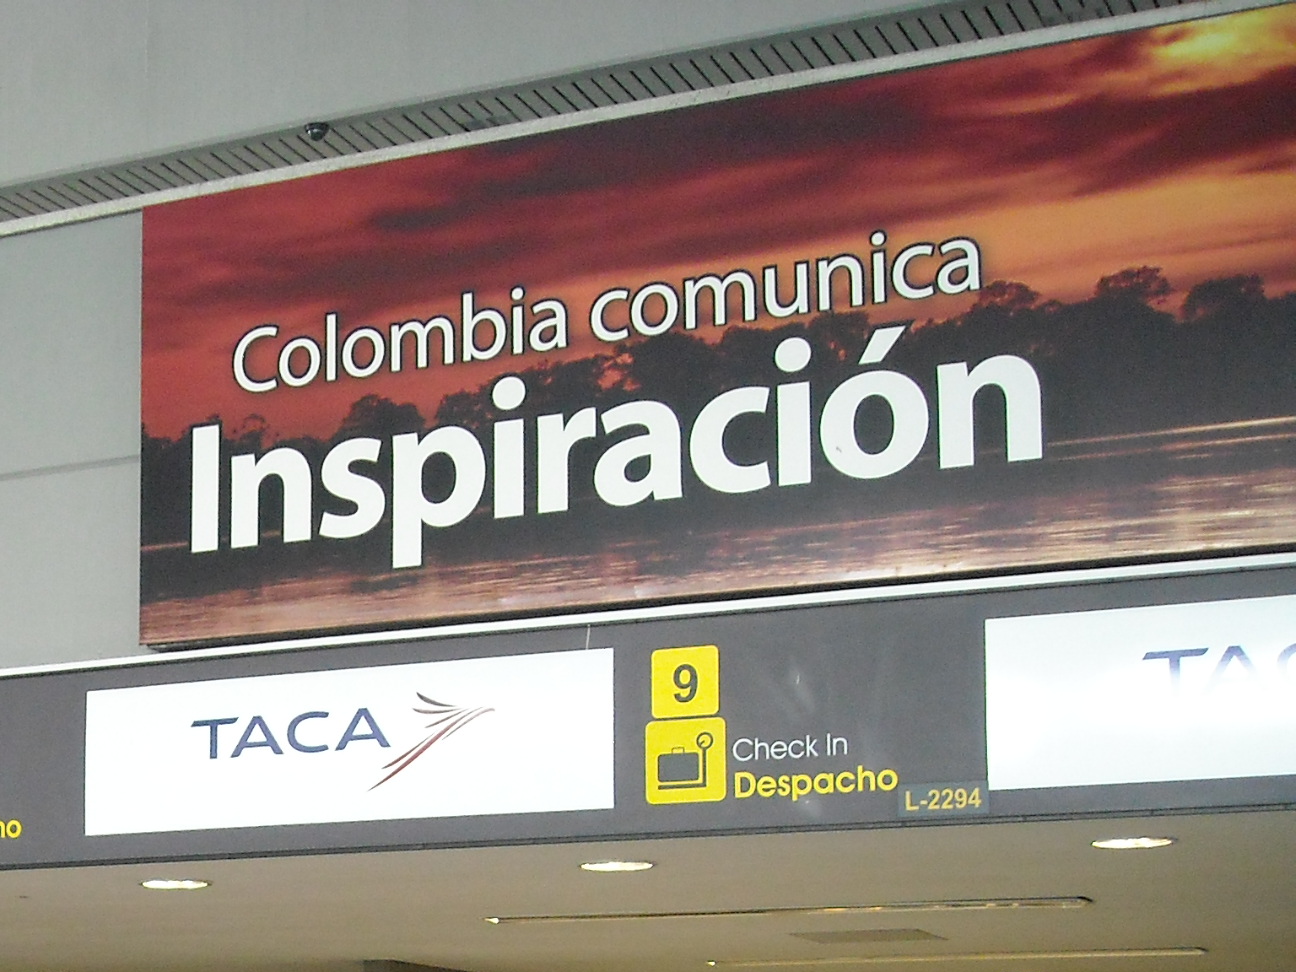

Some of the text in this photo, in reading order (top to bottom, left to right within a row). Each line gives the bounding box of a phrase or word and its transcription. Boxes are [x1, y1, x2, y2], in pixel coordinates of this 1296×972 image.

[232, 230, 984, 393] Colombia comunica
[190, 325, 1044, 569] Inspiración
[672, 663, 699, 703] 9
[1142, 643, 1296, 698] TA
[191, 707, 391, 760] TACA
[732, 733, 849, 763] Check In
[734, 765, 899, 801] Despacho
[905, 787, 982, 812] L-2294
